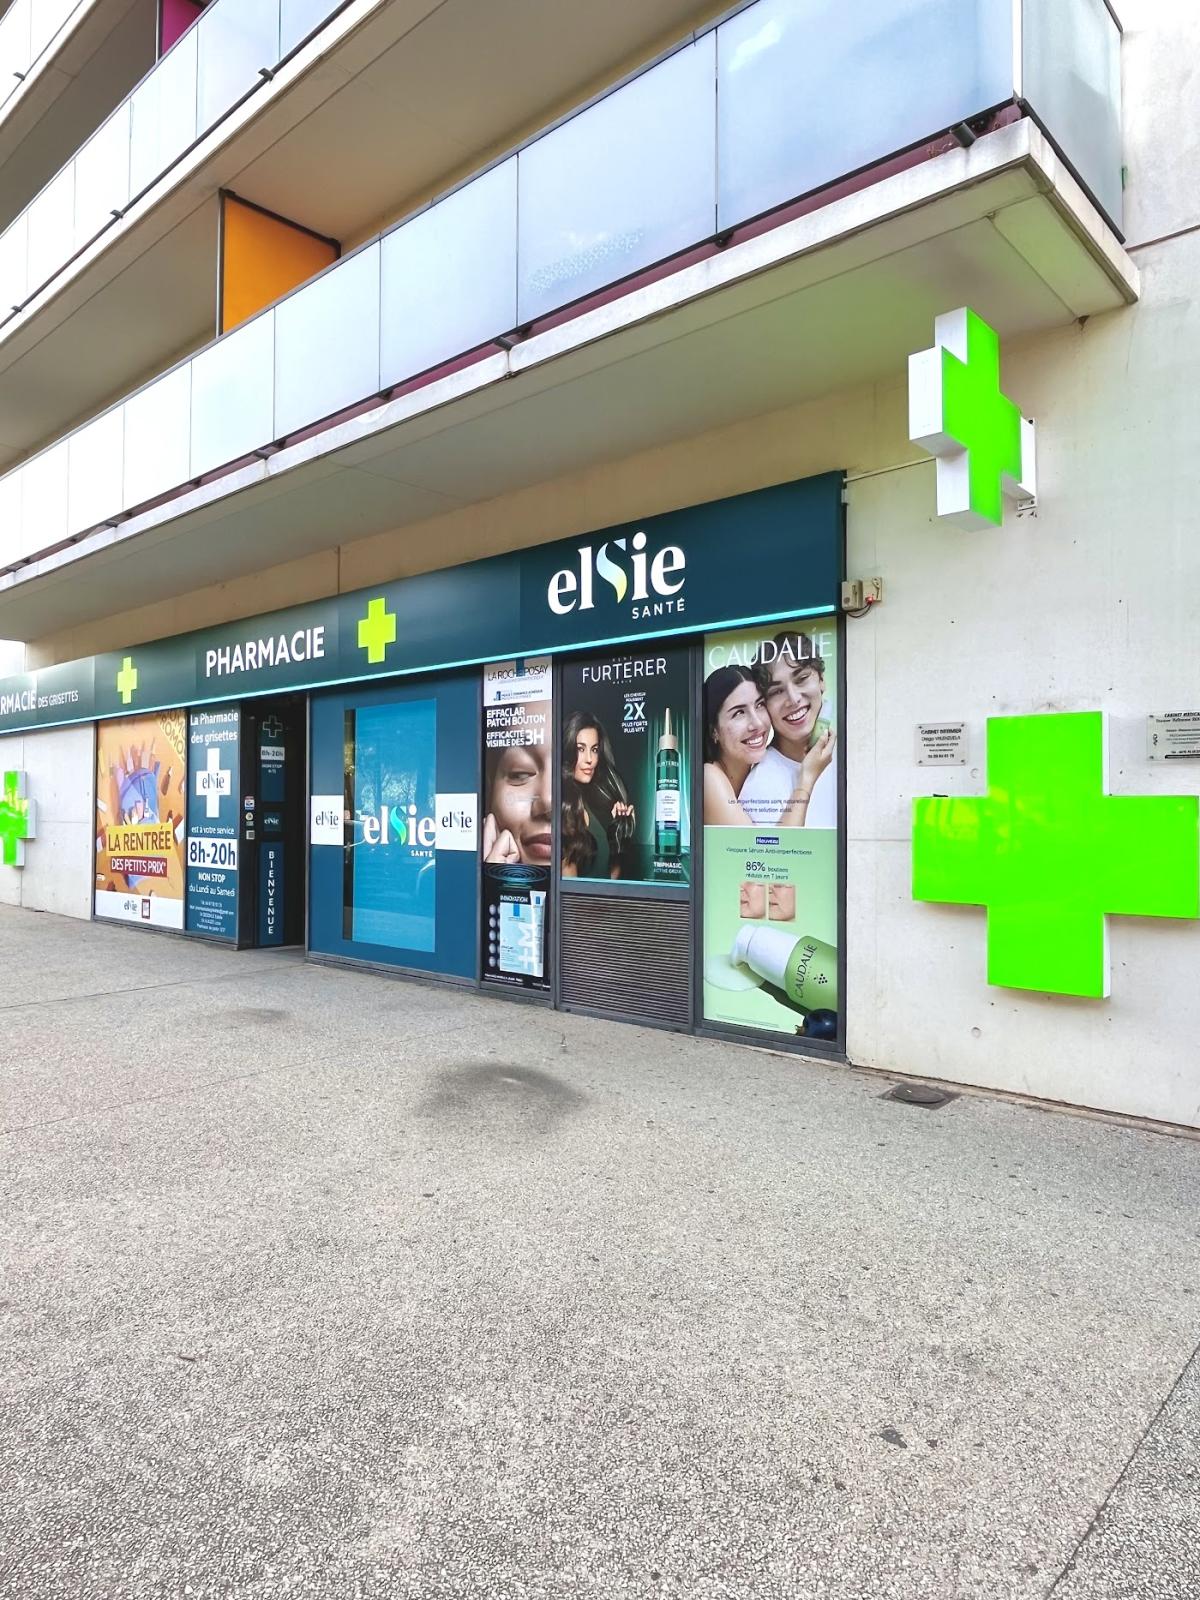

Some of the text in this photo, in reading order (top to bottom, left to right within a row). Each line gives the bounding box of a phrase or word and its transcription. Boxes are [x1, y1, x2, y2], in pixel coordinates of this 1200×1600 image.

[631, 597, 686, 619] SANTÉ
[206, 626, 325, 678] PHARMACIE
[488, 671, 498, 681] LA
[582, 658, 667, 684] FURTERER
[38, 696, 49, 708] DES
[49, 690, 79, 706] GRISETTES
[190, 710, 239, 726] La Pharmacie
[487, 707, 526, 719] EFFACLAR
[623, 702, 646, 720] 2X
[487, 713, 546, 728] PATCH BOUTON
[190, 730, 238, 746] des grisettes
[487, 728, 525, 740] EFFICACITÉ
[525, 728, 545, 746] 3H
[486, 739, 511, 748] VISIBLE
[108, 826, 172, 851] LA RENTRÉE
[216, 827, 235, 835] service
[189, 841, 236, 866] 8h-20h
[111, 858, 123, 871] DES
[124, 859, 147, 873] PETITS
[745, 861, 766, 872] 86%
[198, 872, 226, 883] NON STOP
[196, 885, 209, 893] Lundi
[216, 887, 235, 897] Samedi
[267, 850, 275, 934] BIENVENUE
